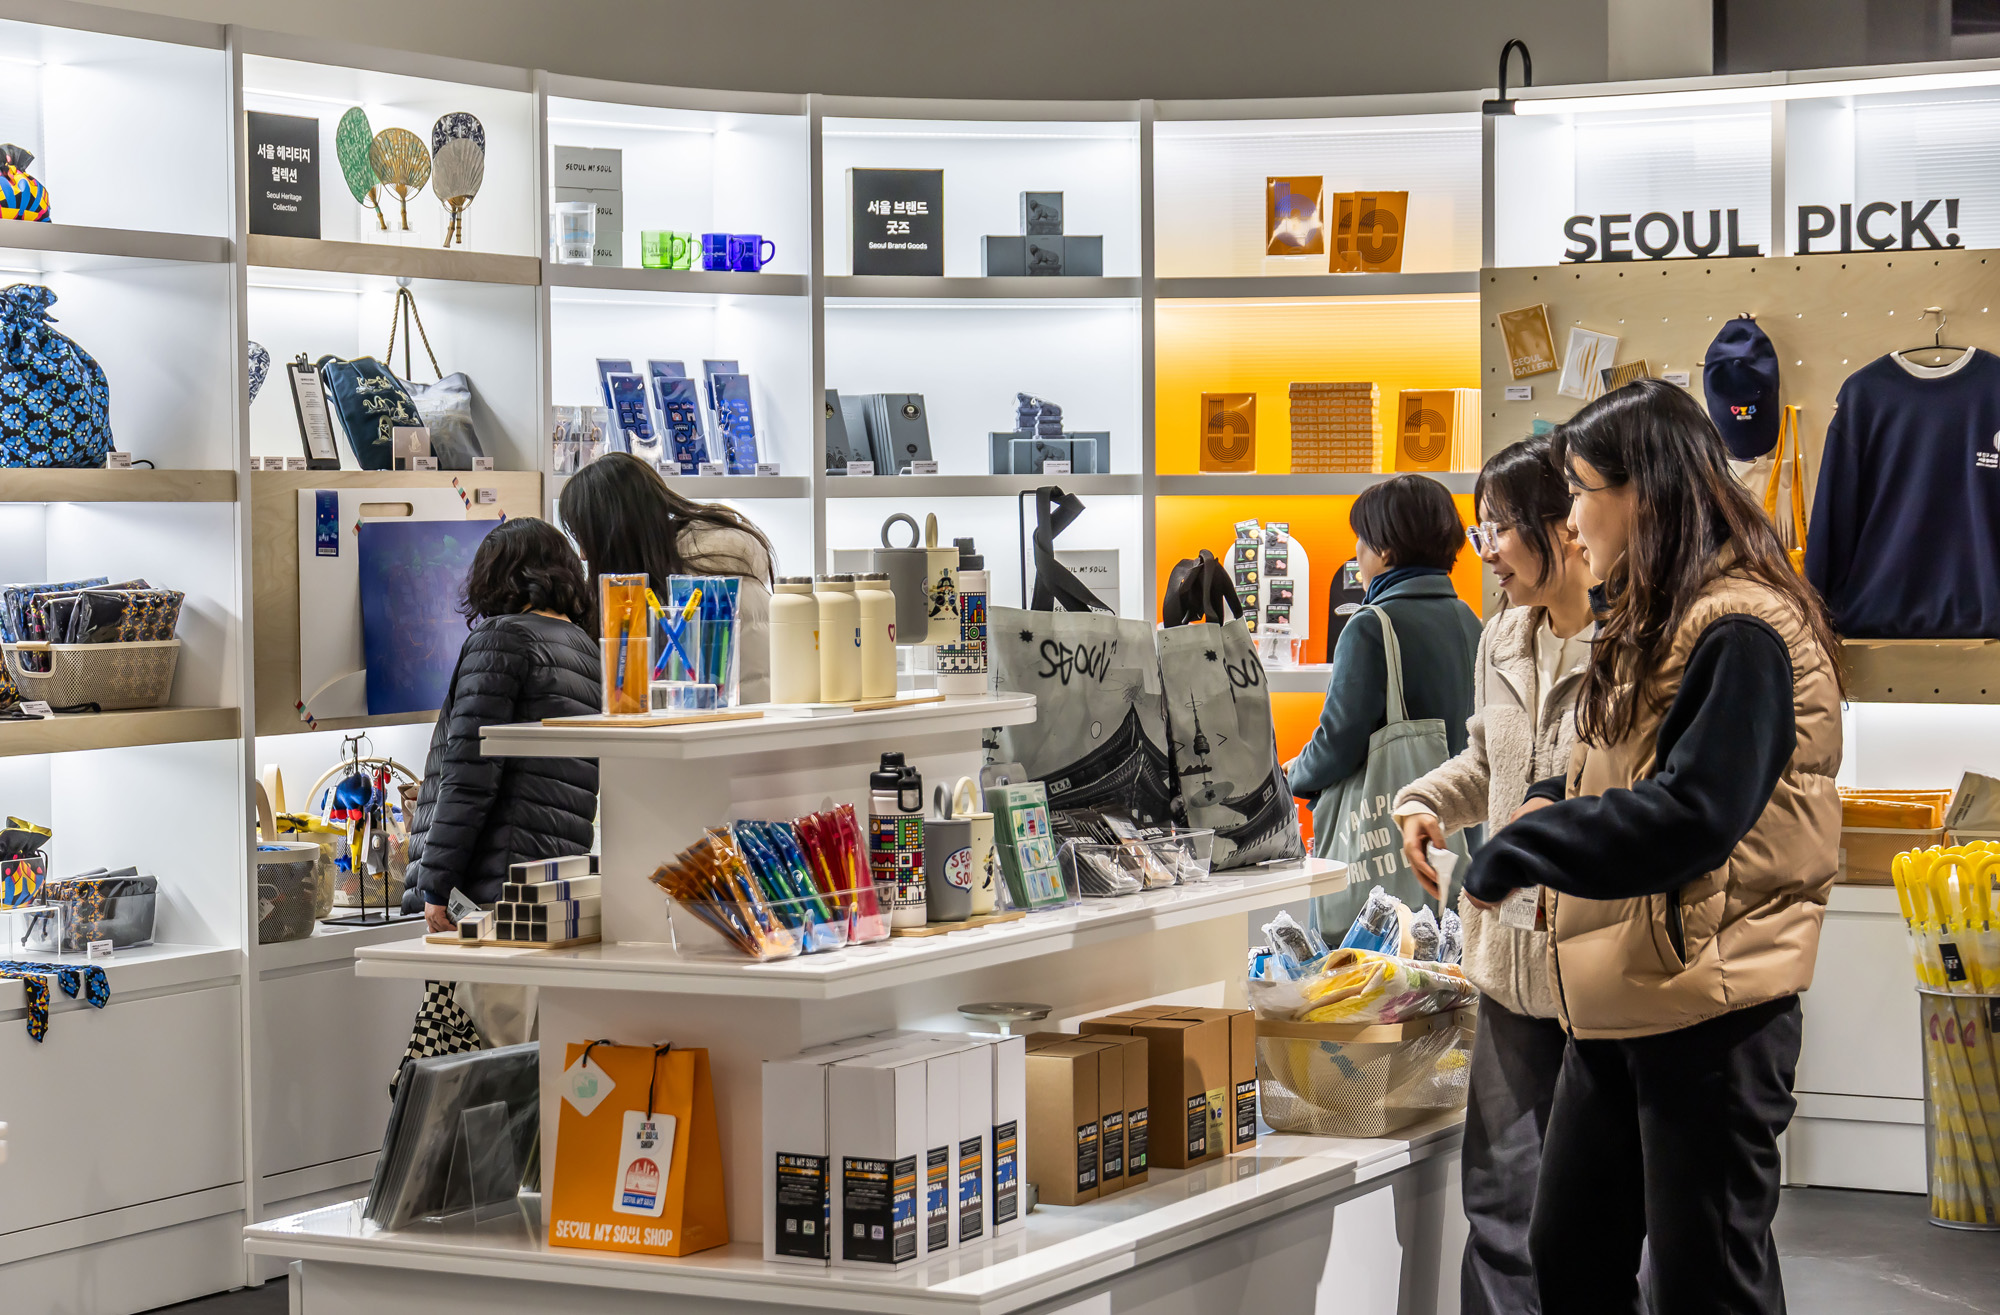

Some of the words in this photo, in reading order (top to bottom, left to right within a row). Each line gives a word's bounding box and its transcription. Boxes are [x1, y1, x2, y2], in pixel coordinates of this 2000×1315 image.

[257, 144, 275, 160] 서울
[276, 145, 311, 163] 헤리티지
[271, 166, 298, 183] 컬렉션
[565, 163, 586, 171] SEOUL
[266, 191, 281, 200] Seoul
[281, 192, 302, 202] Heritage
[272, 203, 298, 212] Collection
[867, 200, 892, 216] 서울
[893, 200, 929, 216] 브랜드
[886, 220, 911, 235] 굿즈
[1564, 208, 1760, 262] SEOUL
[1798, 198, 1960, 253] PICK!
[868, 241, 887, 250] Seoul
[888, 242, 906, 250] Brand
[1513, 353, 1543, 367] SEOUL
[1514, 359, 1554, 376] GALLERY
[1360, 827, 1391, 853] AND
[1372, 852, 1397, 877] TO
[556, 1219, 591, 1240] SEOUL
[644, 1227, 673, 1247] SHOP
